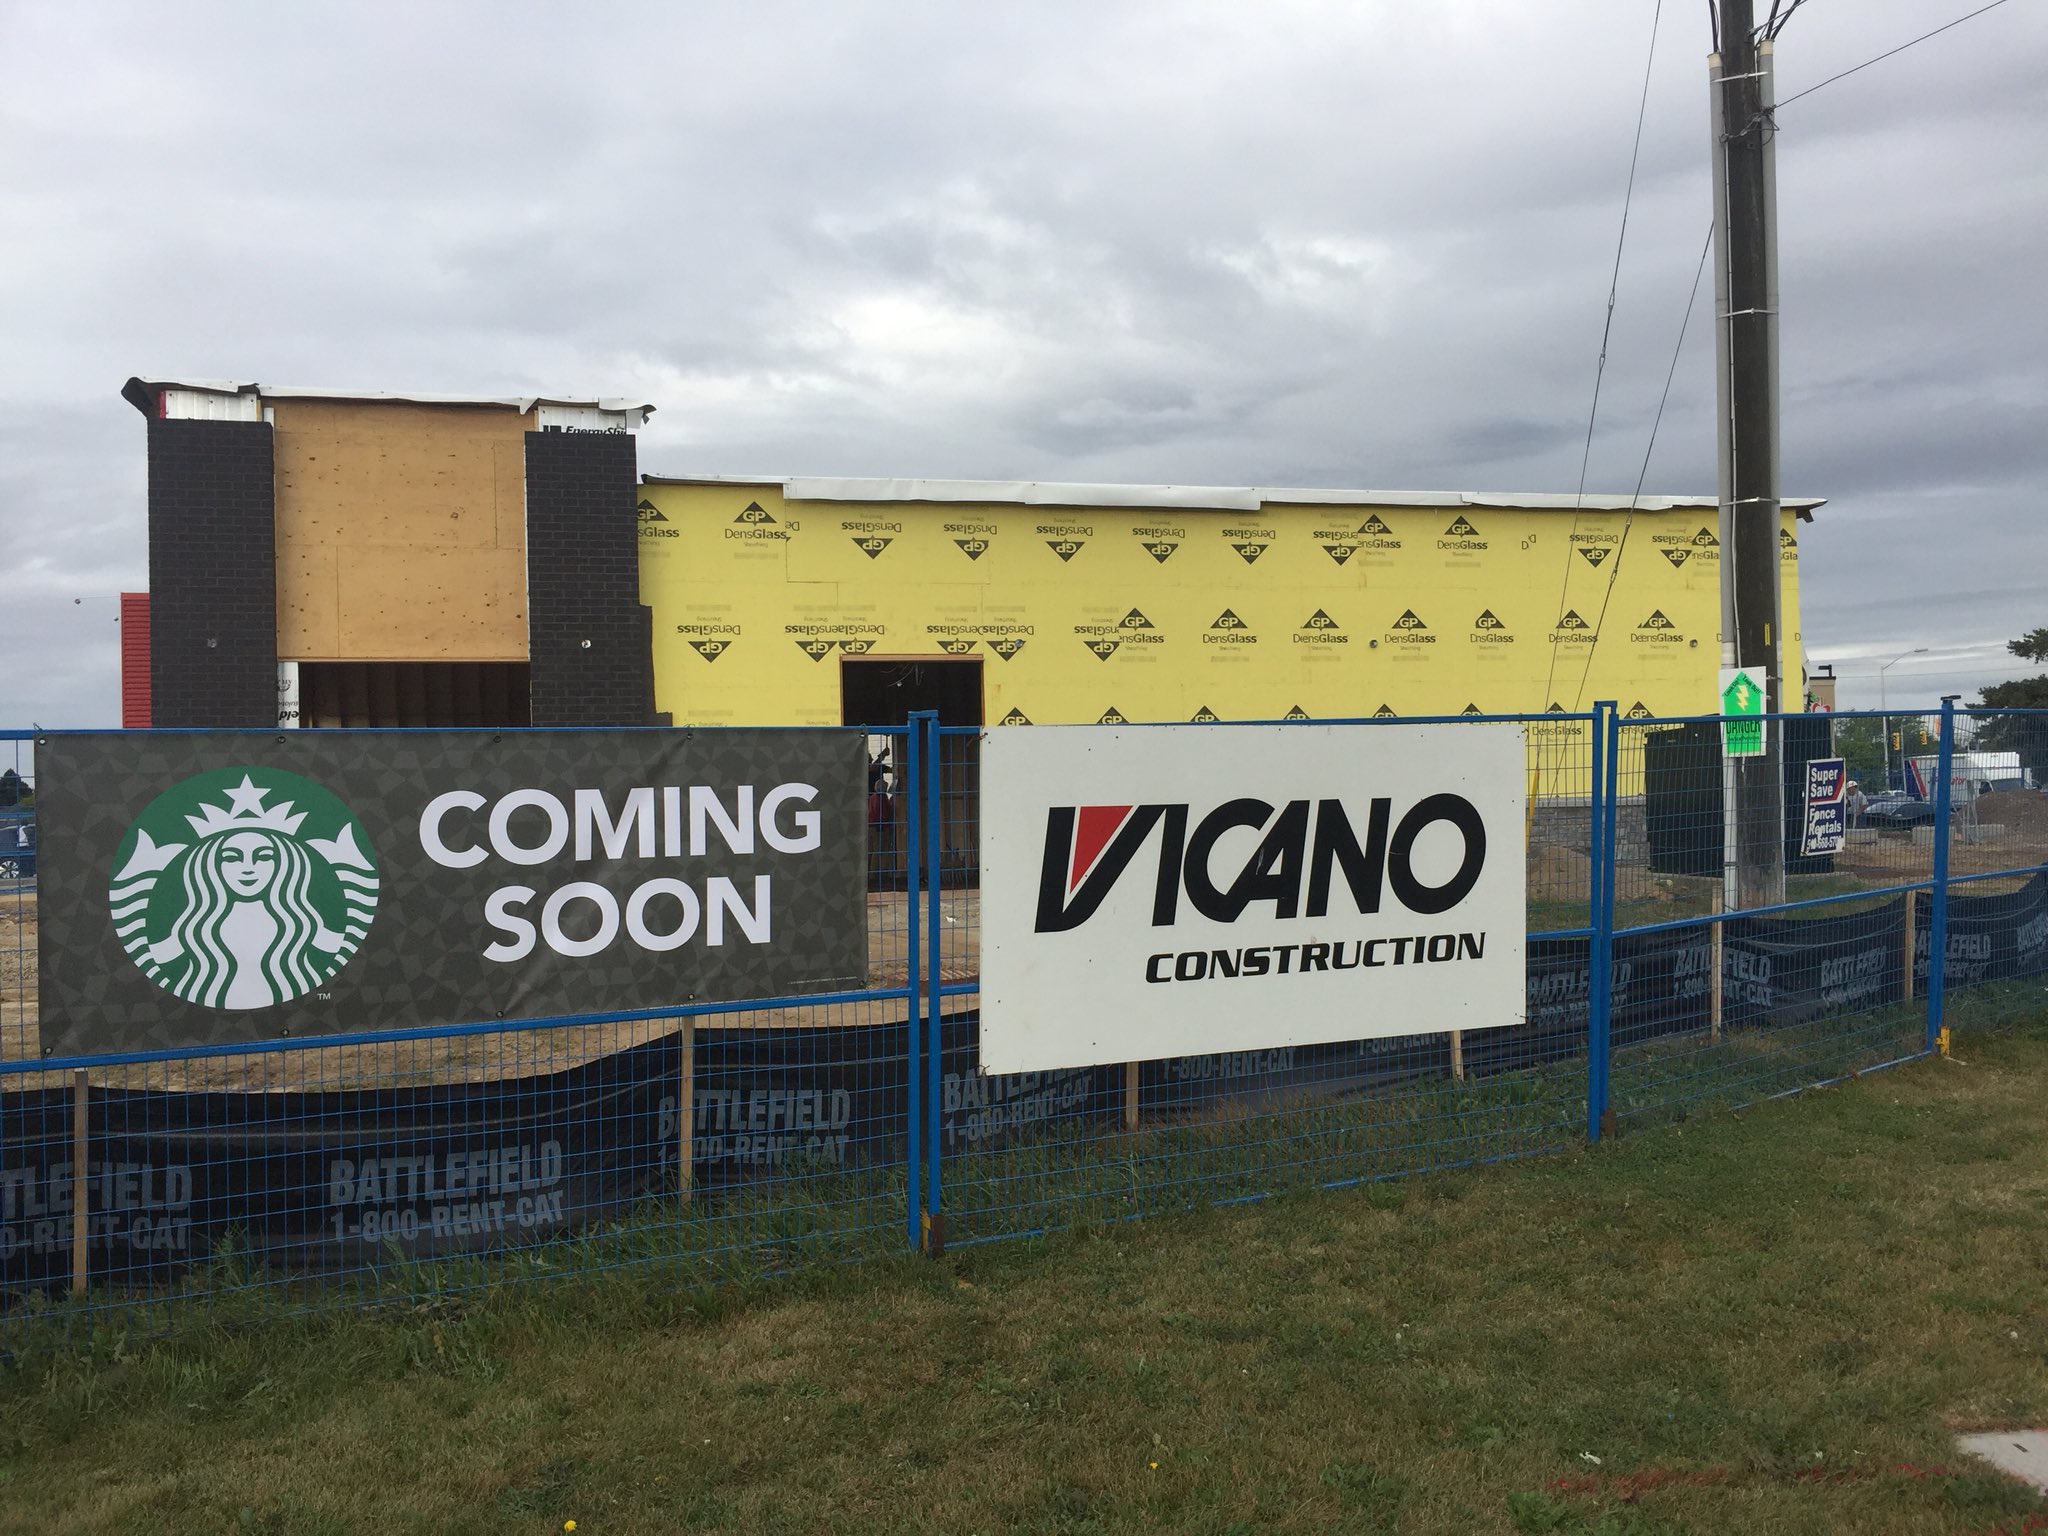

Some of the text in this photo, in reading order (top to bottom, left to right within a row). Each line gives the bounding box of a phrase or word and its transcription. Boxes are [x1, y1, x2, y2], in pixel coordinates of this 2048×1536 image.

[742, 510, 767, 522] GP
[637, 526, 680, 538] sGlass
[842, 521, 902, 533] DensGlass
[1036, 525, 1093, 536] DensGlass
[1132, 527, 1186, 538] DensGlass
[1364, 522, 1384, 533] GP
[1451, 523, 1471, 534] GP
[724, 528, 787, 540] DensGlass
[1222, 529, 1276, 540] DensGlass
[1569, 534, 1619, 544] DensGlass
[861, 539, 885, 551] GP
[1437, 540, 1488, 550] DensGlass
[1695, 536, 1714, 545] GP
[963, 541, 986, 552] GP
[1056, 543, 1077, 553] GP
[1151, 544, 1172, 555] GP
[1240, 545, 1261, 556] GP
[1331, 547, 1351, 557] GP
[1586, 548, 1605, 559] GP
[1669, 549, 1687, 560] GP
[1125, 616, 1146, 627] GP
[1218, 617, 1239, 628] GP
[1310, 617, 1331, 628] GP
[1399, 617, 1419, 627] GP
[1477, 617, 1498, 627] GP
[1562, 617, 1582, 627] GP
[1649, 617, 1667, 627] GP
[677, 624, 741, 635] DensGlass
[1202, 633, 1257, 644] DensGlass
[1384, 634, 1436, 643] DensGlass
[1549, 634, 1598, 643] DensGlass
[698, 642, 723, 654] GP
[805, 642, 829, 654] GP
[845, 641, 868, 654] GP
[947, 642, 969, 653] GP
[997, 643, 1018, 653] GP
[1093, 643, 1115, 653] GP
[1629, 709, 1648, 719] GP
[1811, 767, 1838, 784] Super
[1810, 784, 1834, 798] Save
[1809, 808, 1836, 821] Fence
[418, 782, 822, 869] COMING
[1808, 820, 1842, 836] Rentals
[1034, 793, 1487, 933] VICANO
[482, 874, 772, 963] SOON
[1145, 931, 1486, 984] CONSTRUCTION
[658, 1089, 850, 1141] BTTLEFIELD
[330, 1140, 562, 1206] BATTLEFIELD
[331, 1190, 564, 1243] 1-800-RENT-CAT
